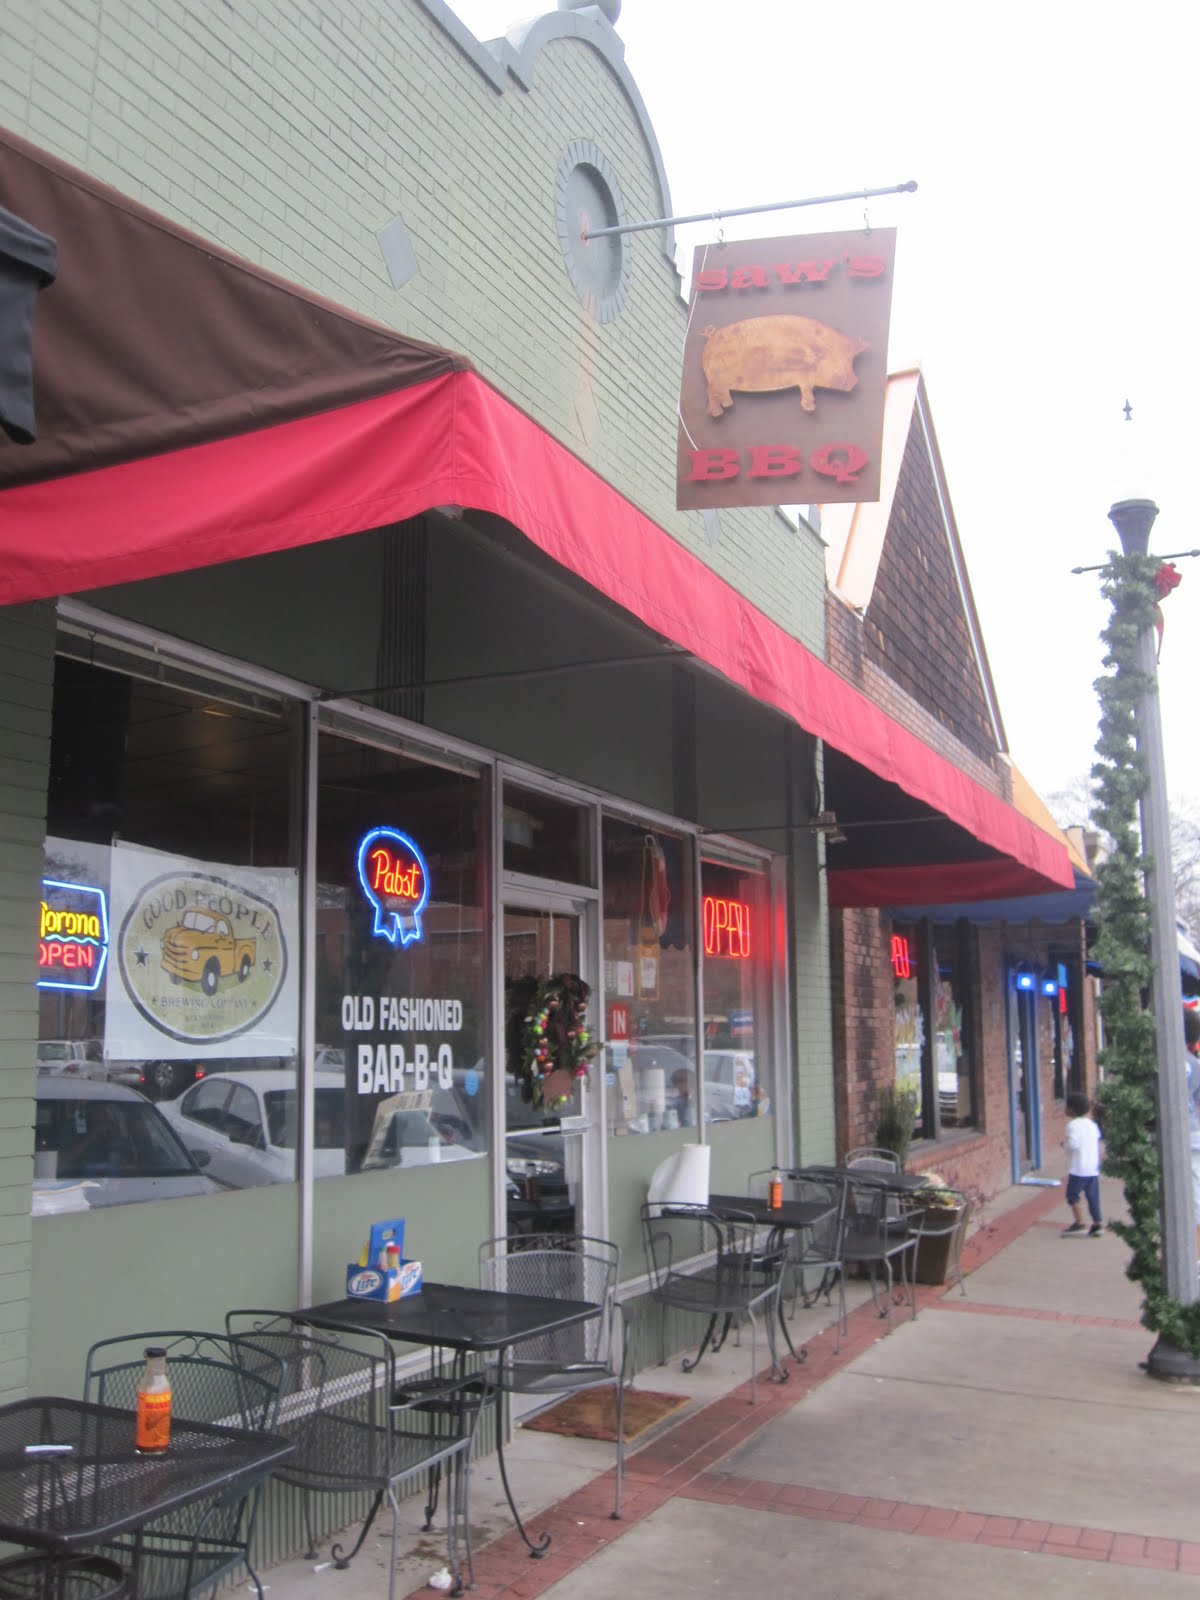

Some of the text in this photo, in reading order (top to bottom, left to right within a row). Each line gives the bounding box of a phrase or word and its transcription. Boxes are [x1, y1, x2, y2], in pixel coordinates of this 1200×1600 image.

[684, 443, 868, 482] BBQ
[372, 849, 421, 899] Pabst
[143, 888, 272, 941] GOOD PEOPLE
[703, 896, 751, 958] OPEN
[160, 995, 207, 1009] BREWING
[342, 995, 463, 1031] OLD FASHIONED
[612, 1008, 626, 1035] IN
[357, 1044, 453, 1095] BAR-B-Q
